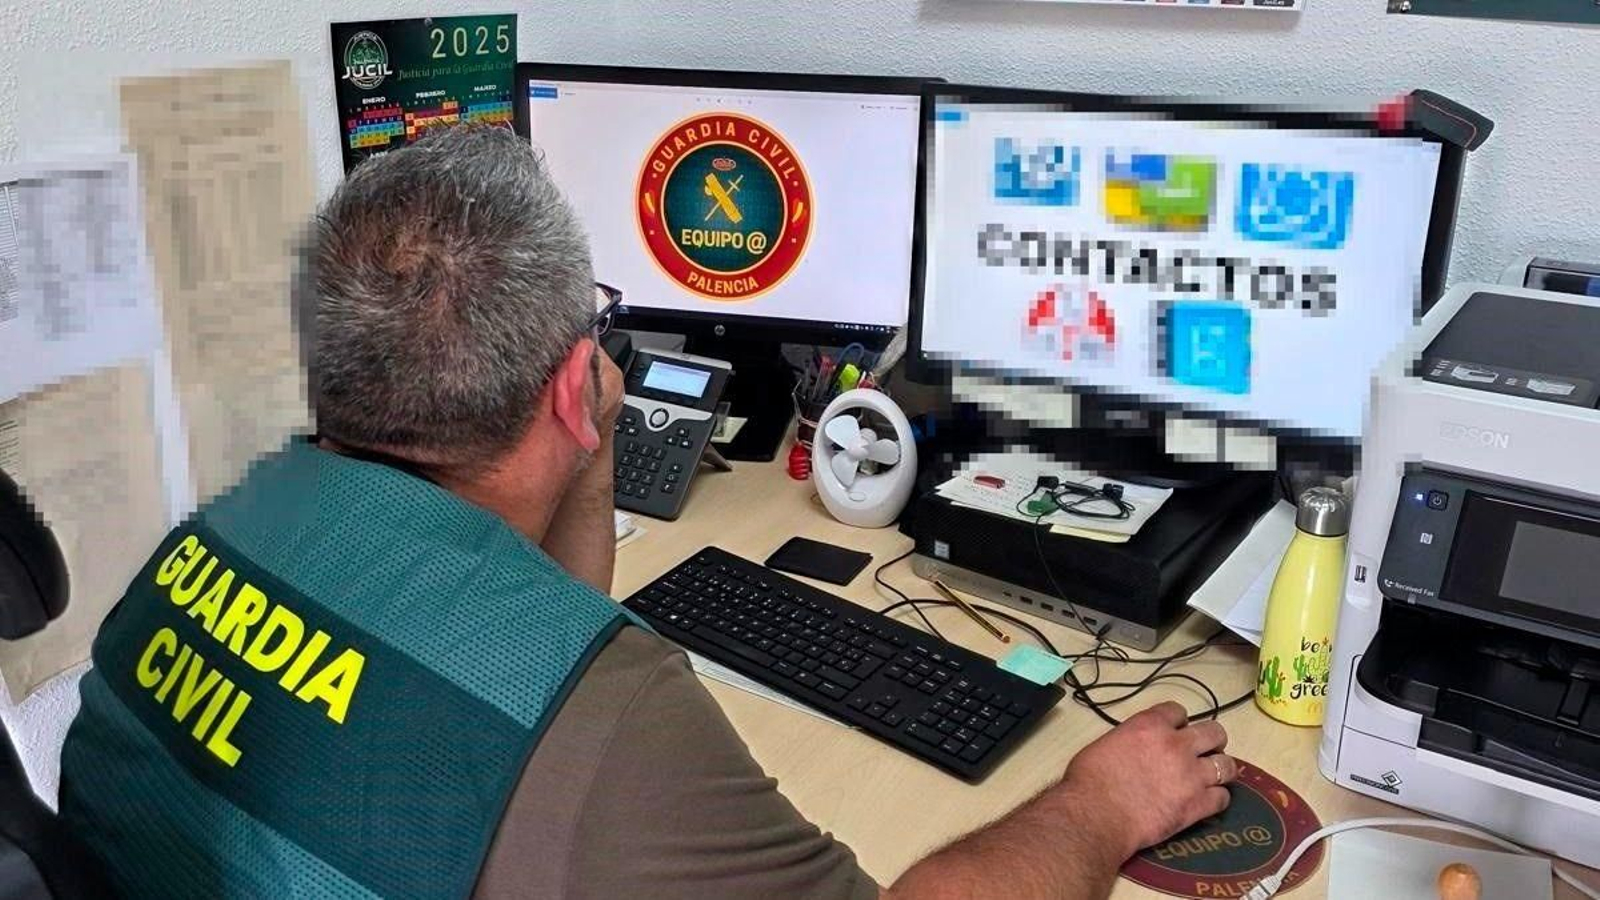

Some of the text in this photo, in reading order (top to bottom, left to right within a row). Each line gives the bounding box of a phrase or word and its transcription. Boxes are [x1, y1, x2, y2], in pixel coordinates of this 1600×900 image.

[430, 25, 510, 58] 2025
[342, 63, 393, 79] JUCIL
[362, 97, 386, 105] ENERO
[652, 121, 797, 180] GUARDIA CIVIL
[682, 228, 767, 254] EQUIPO @
[687, 271, 759, 294] PALENCIA
[977, 223, 1337, 317] CONTACTOS
[156, 535, 365, 725] GUARDIA
[136, 627, 252, 767] CIVIL
[1155, 826, 1273, 860] EQUIPO @
[1195, 870, 1300, 897] PALEA
